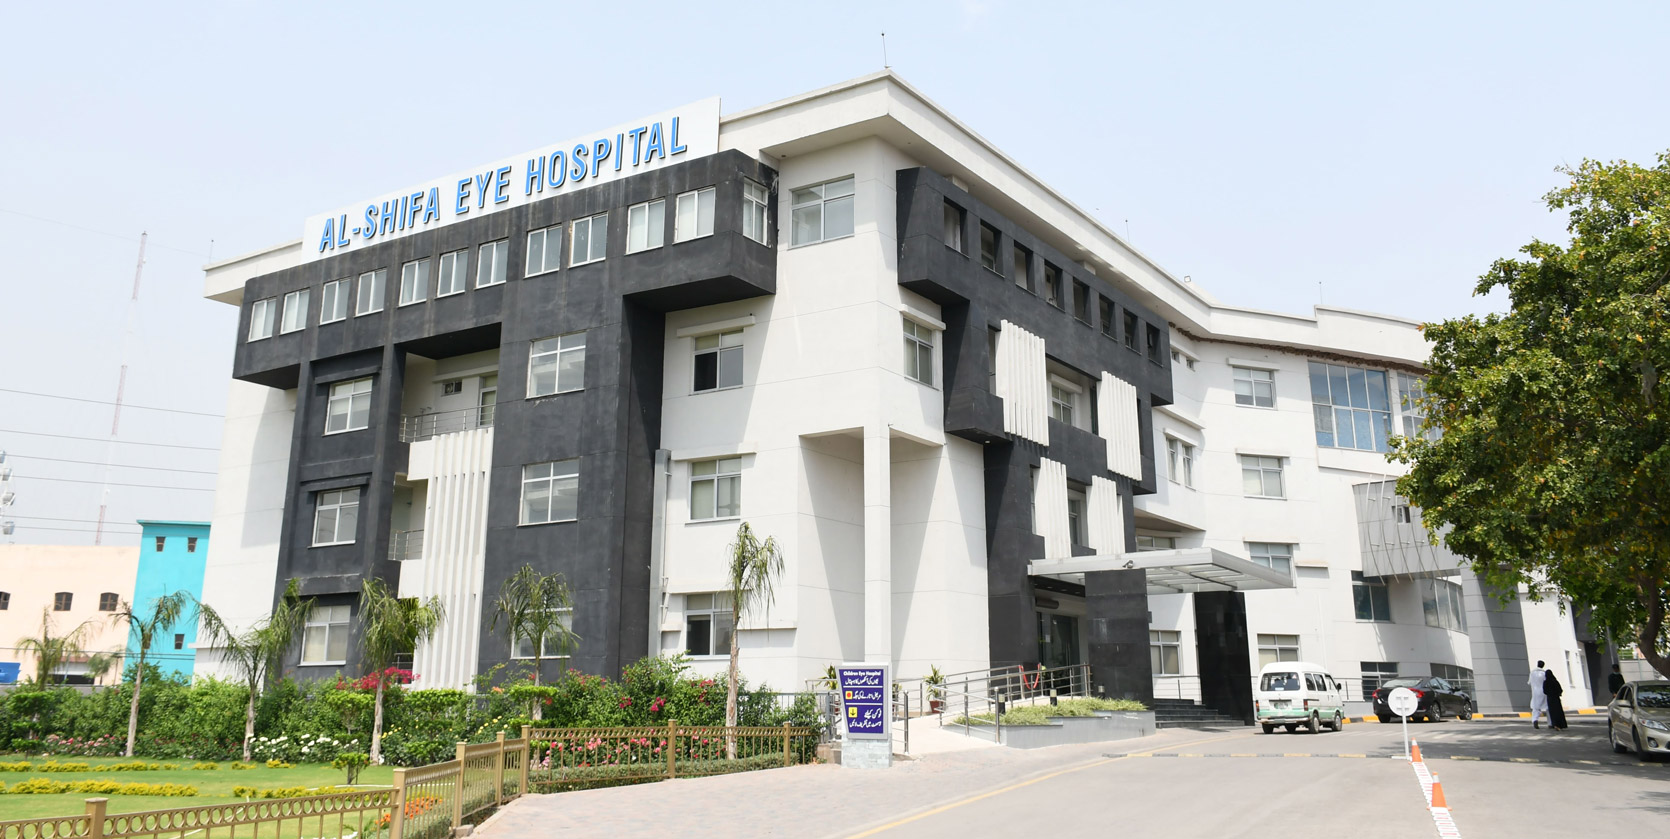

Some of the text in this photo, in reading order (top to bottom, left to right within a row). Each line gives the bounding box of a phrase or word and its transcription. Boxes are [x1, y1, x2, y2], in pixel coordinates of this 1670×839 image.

[319, 116, 687, 252] AL-SHIFA EYE HOSPITAL
